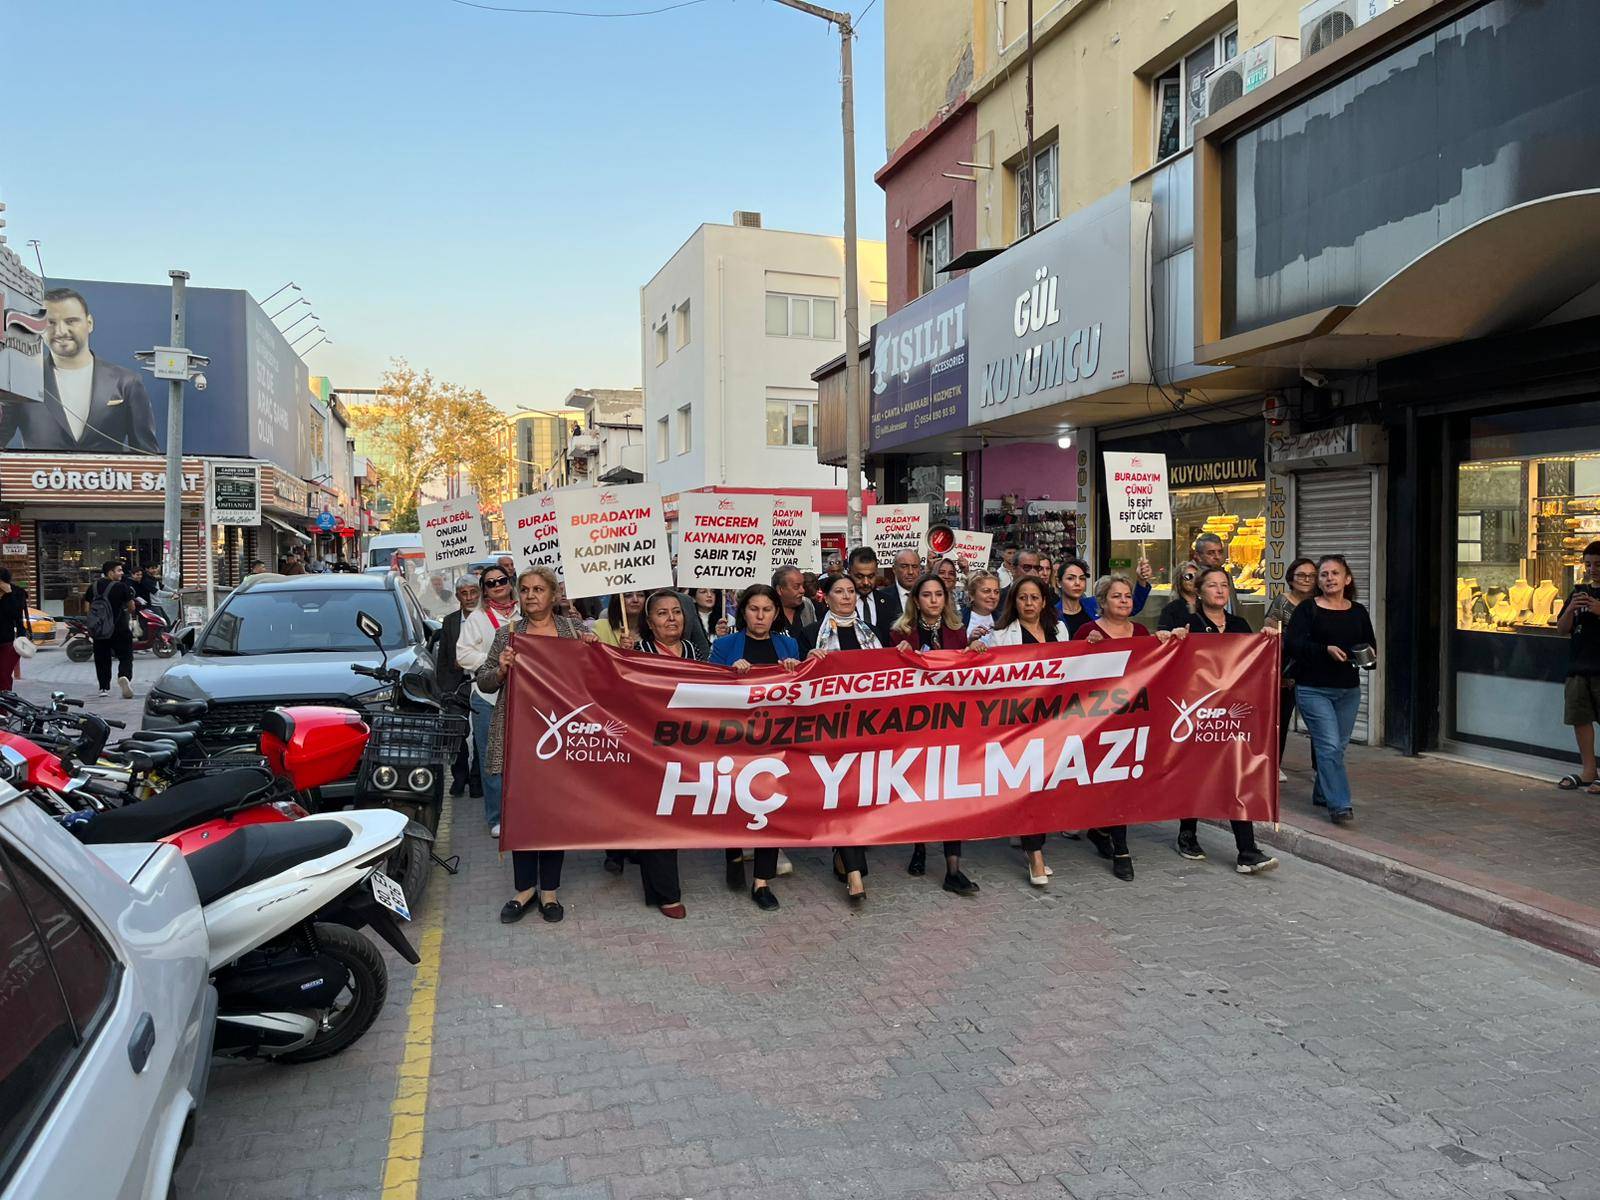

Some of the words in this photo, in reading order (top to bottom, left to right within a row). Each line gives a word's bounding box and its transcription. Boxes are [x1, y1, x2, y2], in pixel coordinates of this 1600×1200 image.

[1014, 265, 1060, 338] GÜL
[891, 303, 965, 383] IŞILTI
[931, 354, 964, 375] ACCESSORIES
[980, 322, 1102, 408] KUYUMCU
[1115, 472, 1161, 482] BURADAYIM
[1170, 459, 1258, 484] KUYUMCULUK
[31, 467, 133, 490] GÖRGÜN
[1125, 484, 1153, 497] ÇÜNKÜ
[1128, 496, 1135, 509] İŞ
[1137, 497, 1152, 509] EŞİT
[426, 516, 449, 529] AÇLIK
[571, 507, 650, 526] BURADAYIM
[694, 515, 759, 528] TENCEREM
[876, 516, 920, 524] BURADAYIM
[1120, 510, 1136, 523] EŞİT
[1137, 510, 1163, 520] ÜCRET
[436, 524, 467, 537] ONURLU
[590, 523, 637, 543] ÇÜNKÜ
[885, 524, 911, 533] ÇÜNKÜ
[1131, 522, 1155, 533] DEĞİL!
[441, 536, 467, 548] YAŞAM
[684, 531, 767, 546] KAYNAMIYOR,
[875, 533, 903, 541] AKP'NİN
[905, 532, 921, 540] AİLE
[575, 541, 630, 558] KADININ
[634, 539, 655, 550] ADI
[694, 549, 729, 560] SABIR
[732, 550, 757, 564] TAŞI
[581, 561, 611, 573] VAR,
[614, 555, 655, 570] HAKKI
[694, 565, 756, 578] ÇATLIYOR!
[605, 574, 636, 586] YOK.
[747, 685, 802, 705] BOŞ
[808, 672, 914, 699] TENCERE
[920, 660, 1066, 688] KAYNAMAZ,
[652, 721, 711, 747] BU
[714, 704, 851, 747] DÜZENİ
[855, 700, 967, 737] KADIN
[975, 687, 1150, 727] YIKMAZSA
[1196, 708, 1228, 719] CHP
[567, 722, 602, 735] CHP
[1195, 719, 1240, 731] KADIN
[566, 735, 620, 748] KADIN
[1194, 731, 1251, 743] KOLLARI
[565, 749, 631, 763] KOLLARI
[809, 726, 1150, 810] YIKILMAZ!
[378, 890, 392, 907] 80
